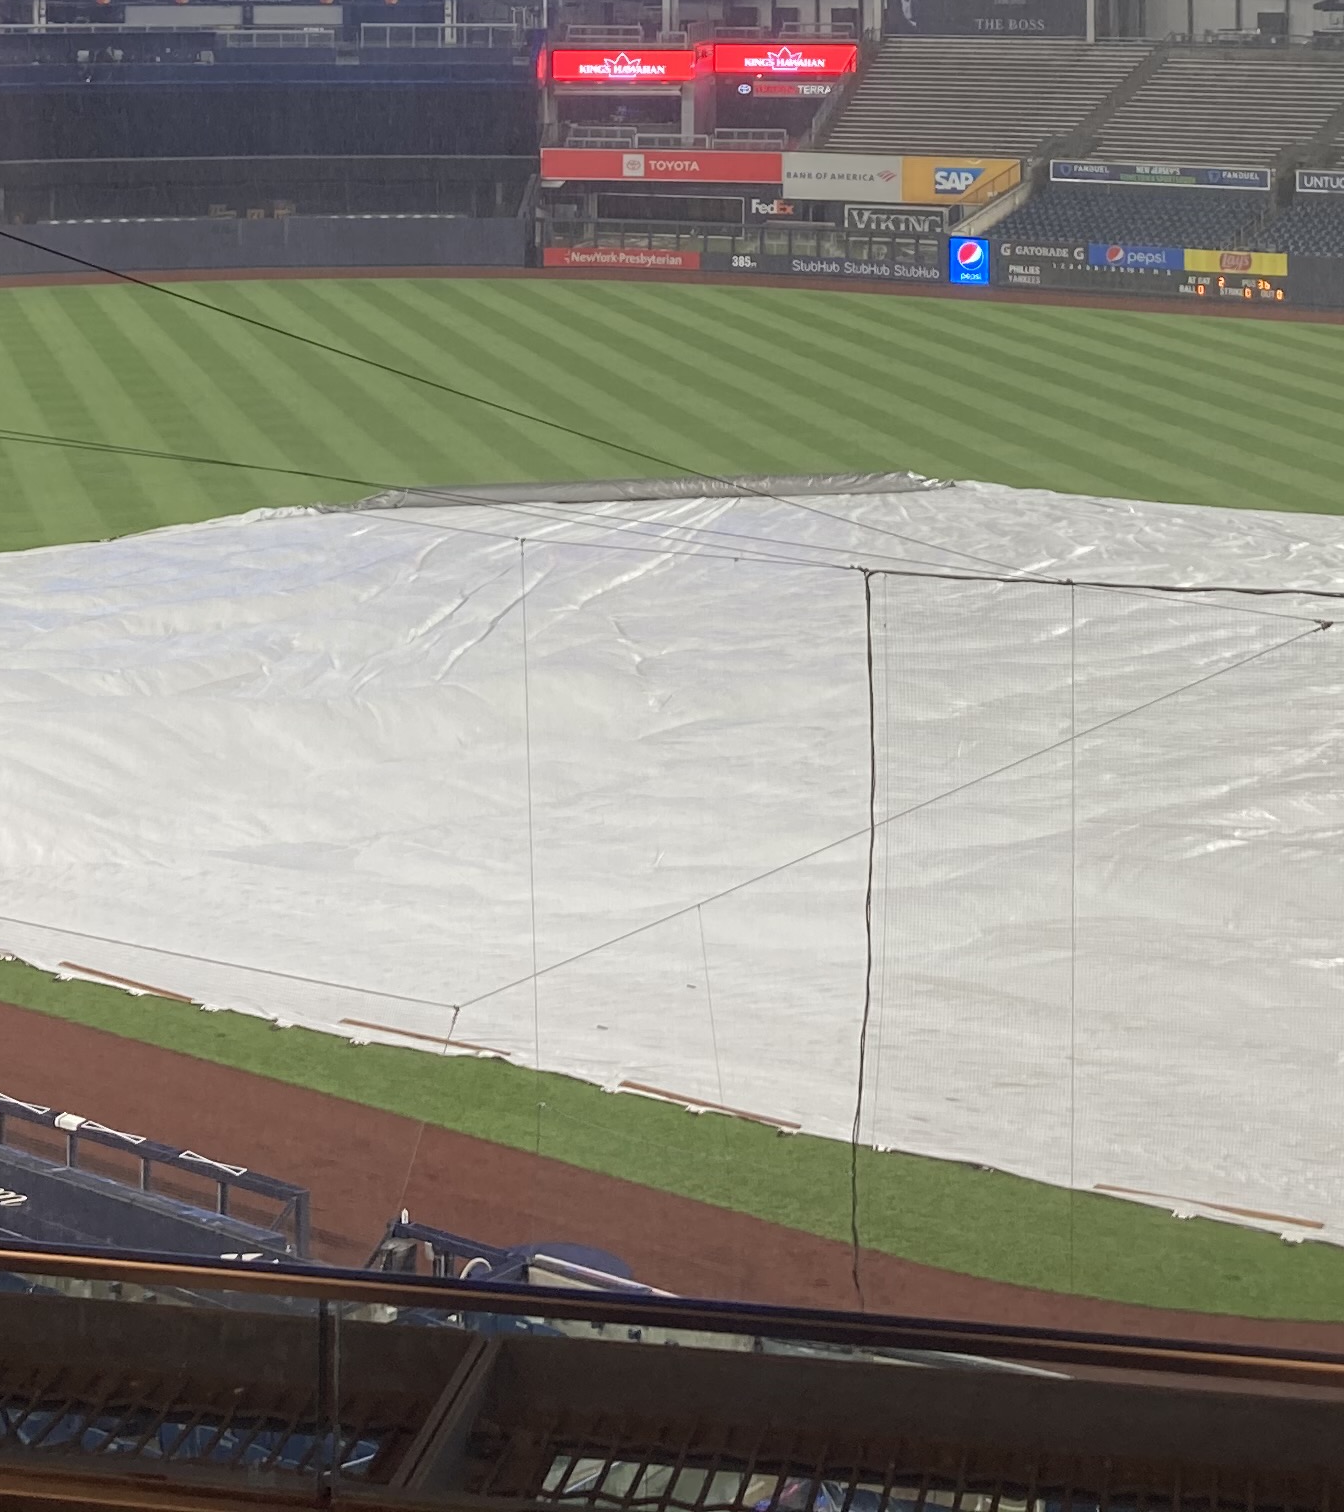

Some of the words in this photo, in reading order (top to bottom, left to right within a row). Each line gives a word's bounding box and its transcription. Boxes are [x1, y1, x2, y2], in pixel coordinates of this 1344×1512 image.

[976, 19, 1004, 30] THE
[1009, 19, 1045, 30] BOSS
[649, 160, 700, 172] TOYOTA
[786, 172, 813, 180] BANK
[829, 173, 875, 182] AMERICA
[934, 170, 974, 190] SAP
[751, 199, 794, 214] FedEx
[850, 210, 941, 232] VIKING
[1001, 244, 1011, 256] G
[1016, 245, 1069, 258] GATORADE
[1073, 247, 1084, 260] G
[1127, 250, 1166, 265] pepsi
[732, 256, 751, 268] 385
[792, 259, 840, 273] StubHub
[844, 261, 891, 275] StubHub
[894, 264, 939, 279] StubHub
[1009, 265, 1040, 275] PHILLIES
